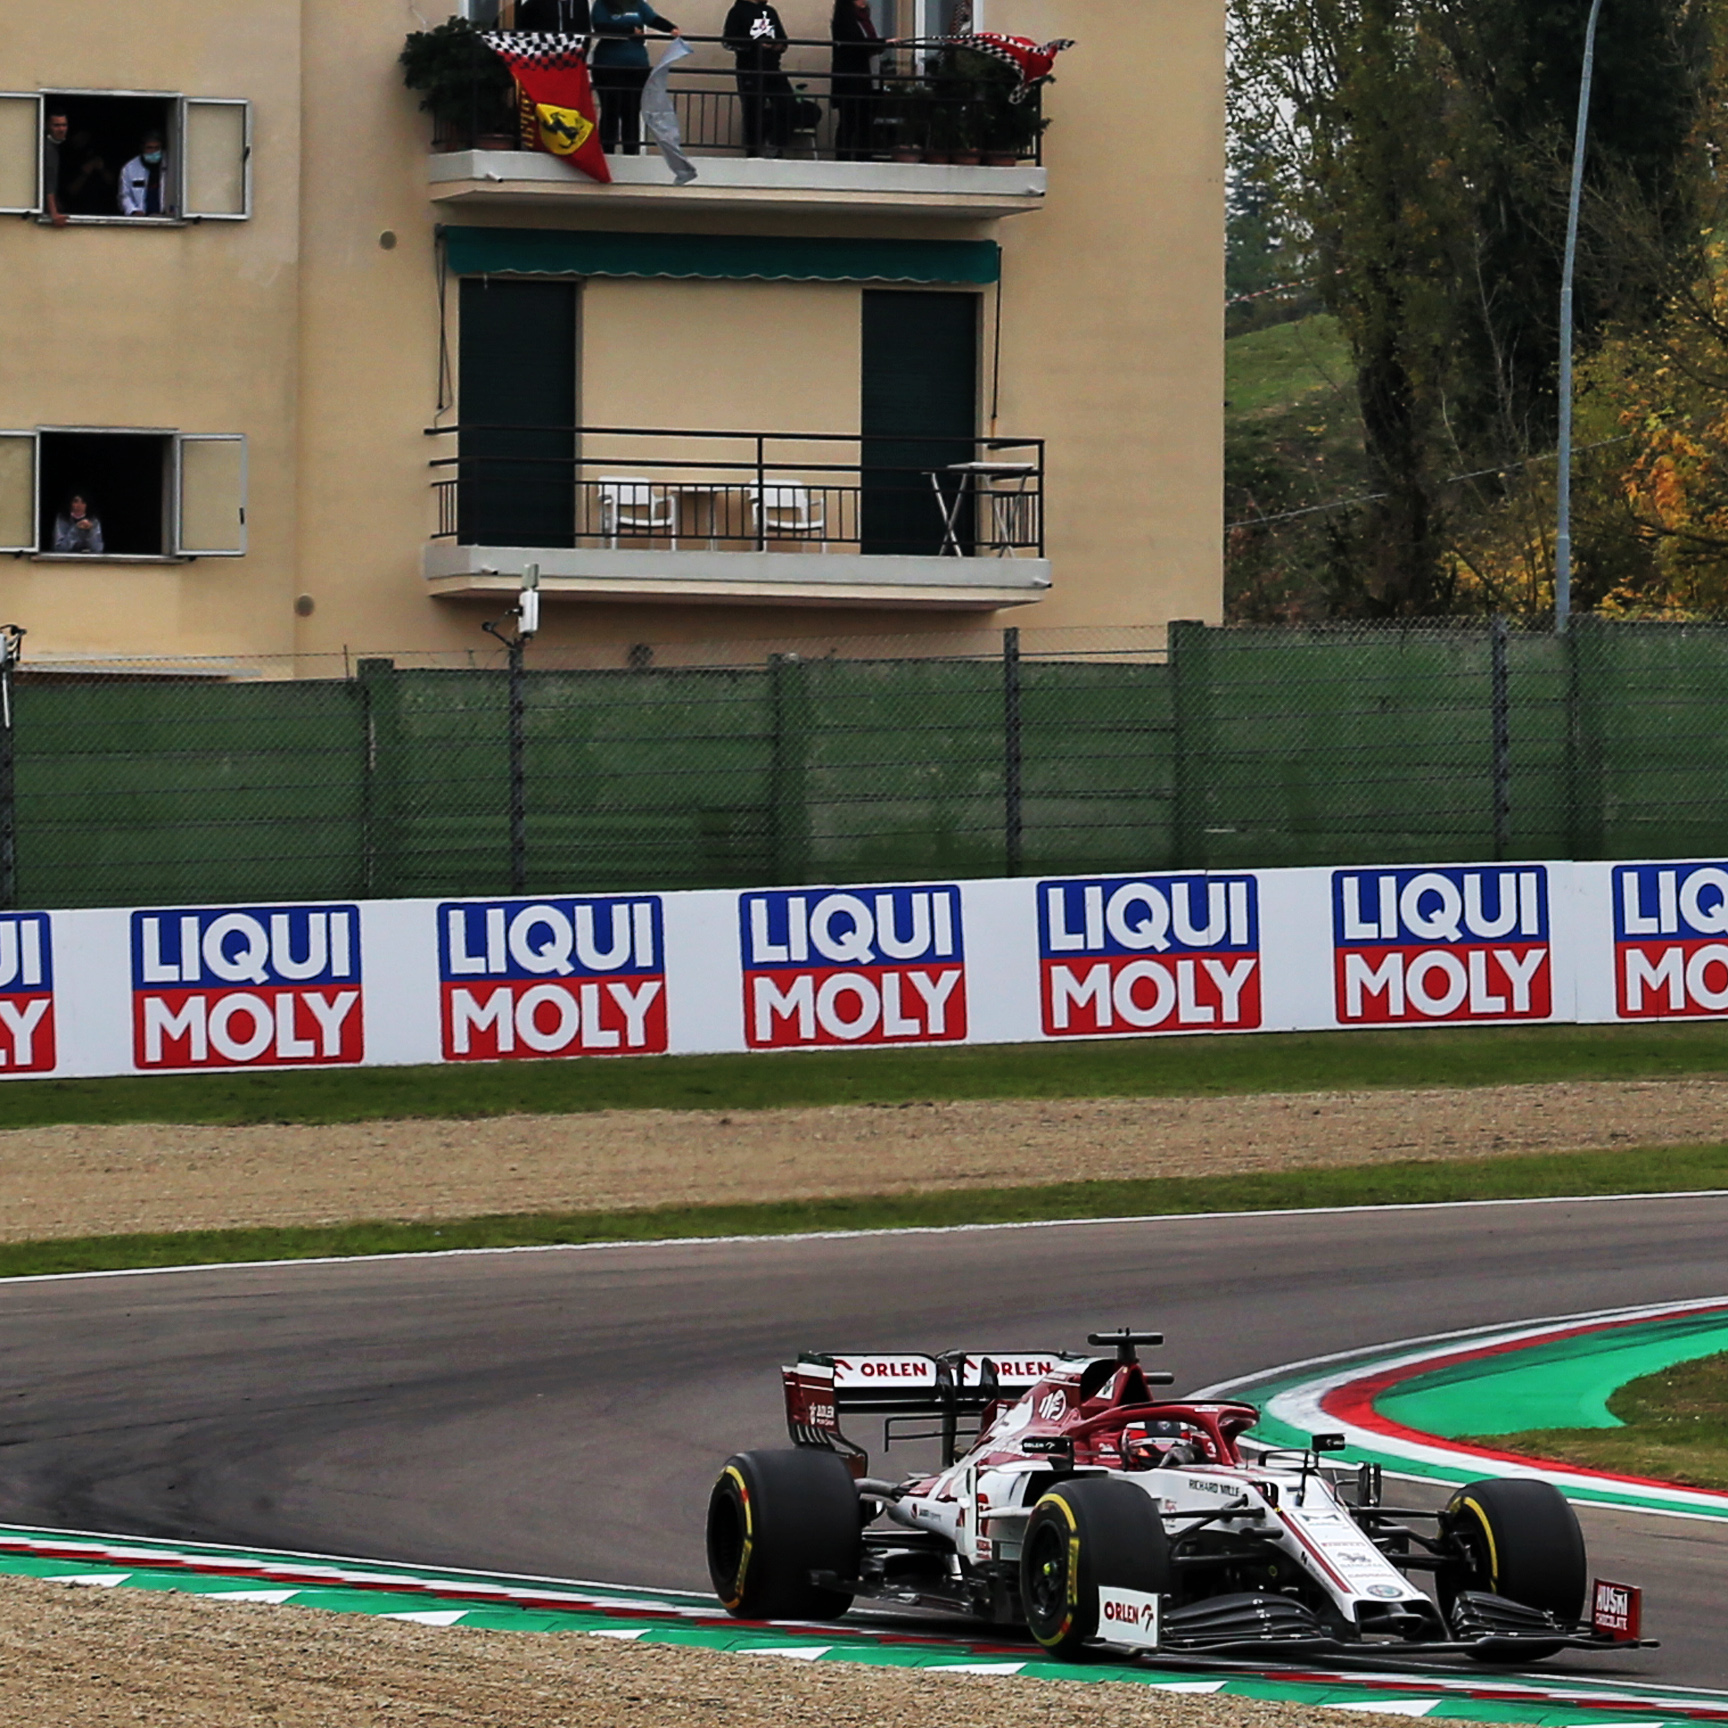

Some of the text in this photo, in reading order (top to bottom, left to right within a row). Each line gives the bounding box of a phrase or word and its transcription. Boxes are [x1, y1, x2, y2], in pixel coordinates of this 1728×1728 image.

[447, 903, 653, 976] LIQUI
[749, 892, 953, 964] LIQUI
[1047, 882, 1248, 952] LIQUI
[1342, 874, 1538, 941] LIQUI
[141, 912, 350, 984] LIQUI
[755, 971, 962, 1043] MOLY
[1052, 960, 1256, 1029] MOLY
[1346, 950, 1546, 1017] MOLY
[145, 993, 358, 1061] MOLY
[453, 983, 663, 1055] MOLY
[860, 1362, 928, 1377] ORLEN
[1189, 1478, 1218, 1494] RICHARD
[1104, 1600, 1140, 1625] ORLEN
